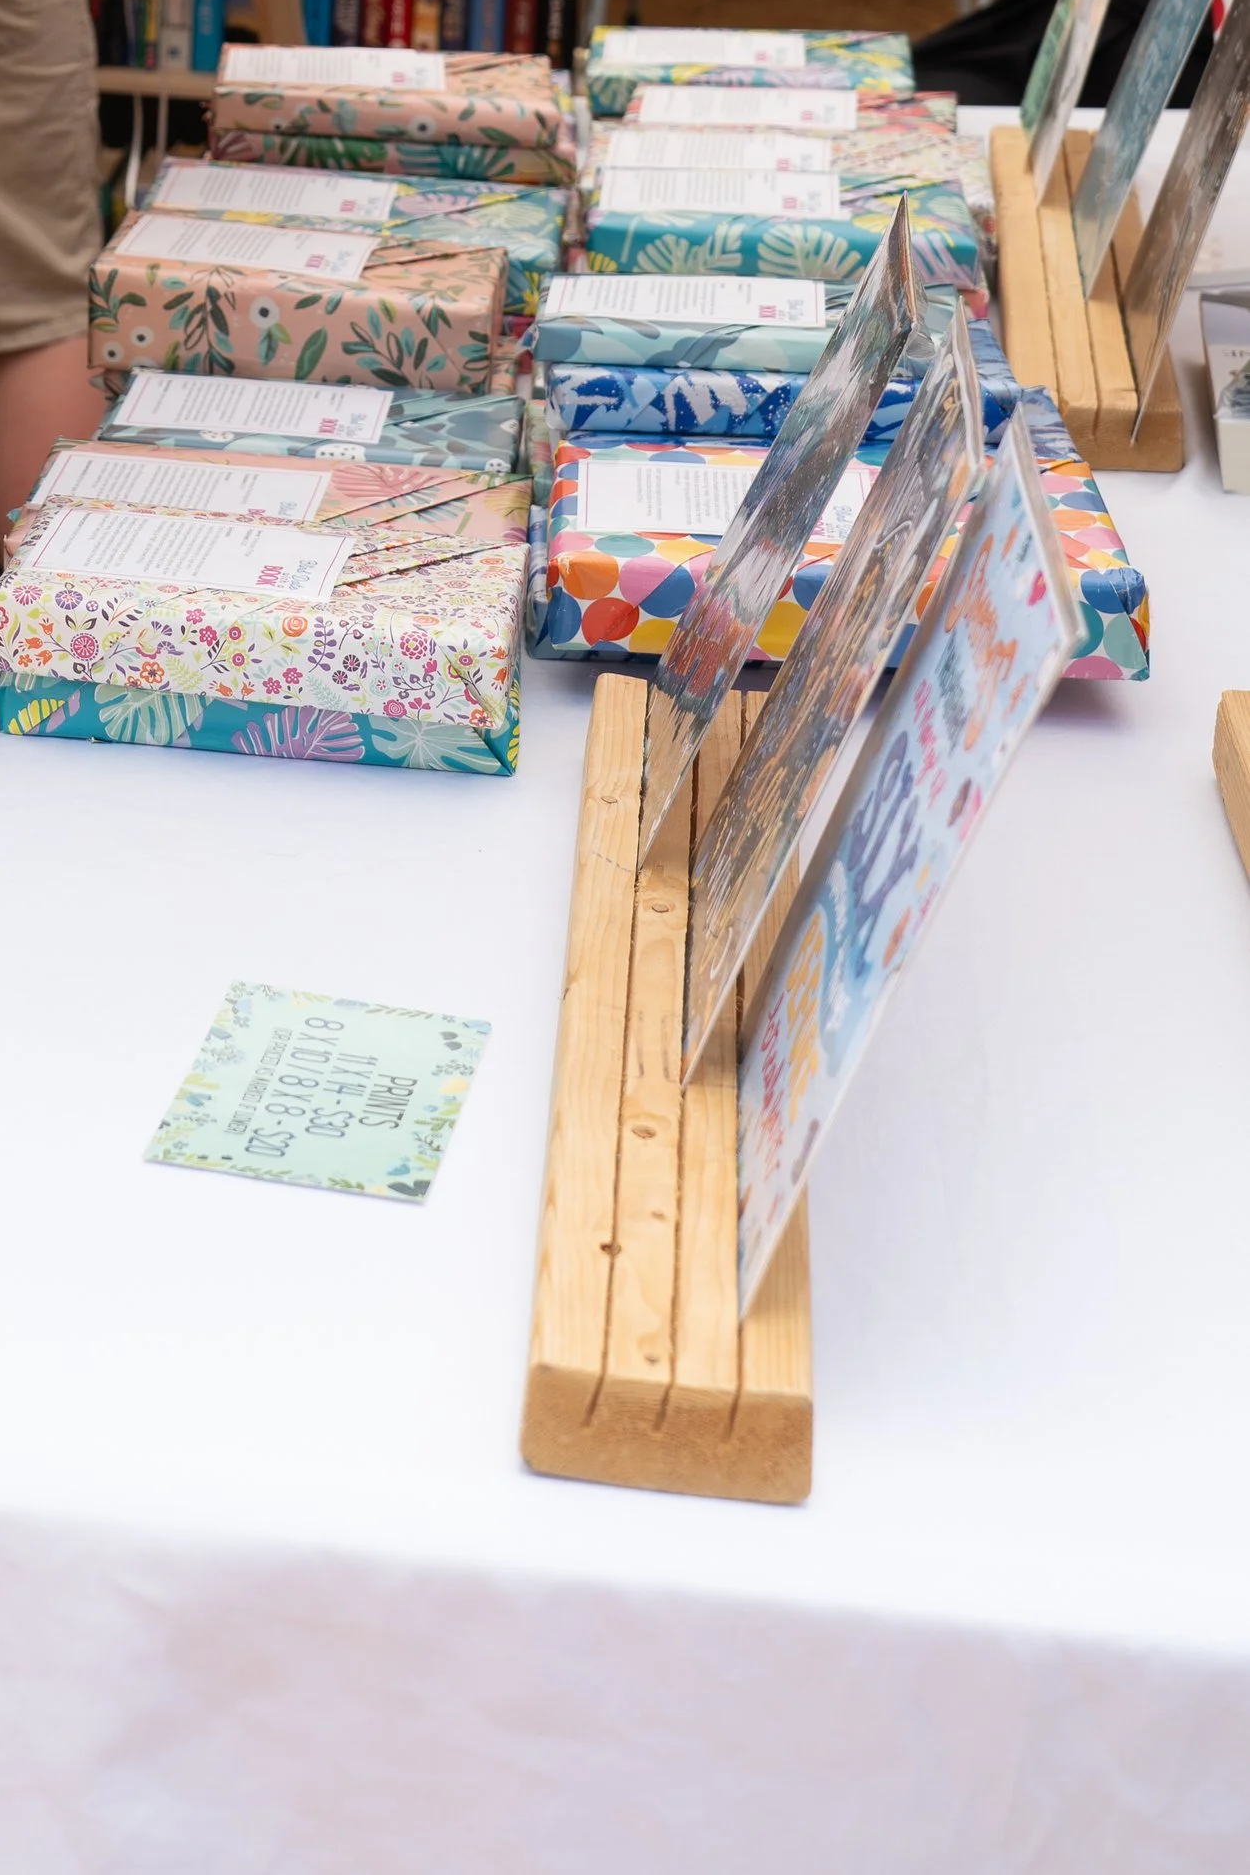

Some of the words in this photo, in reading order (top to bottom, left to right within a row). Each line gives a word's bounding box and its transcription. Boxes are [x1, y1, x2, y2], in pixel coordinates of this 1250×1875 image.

[255, 565, 284, 587] BOOK
[302, 1015, 345, 1032] 8
[288, 1046, 332, 1064] 10
[335, 1050, 378, 1066] 11
[276, 1073, 320, 1089] 8
[322, 1078, 366, 1097] 14
[262, 1101, 307, 1118] 8
[357, 1072, 417, 1130] PRINTS
[302, 1105, 355, 1139] $30
[242, 1126, 296, 1159] $20
